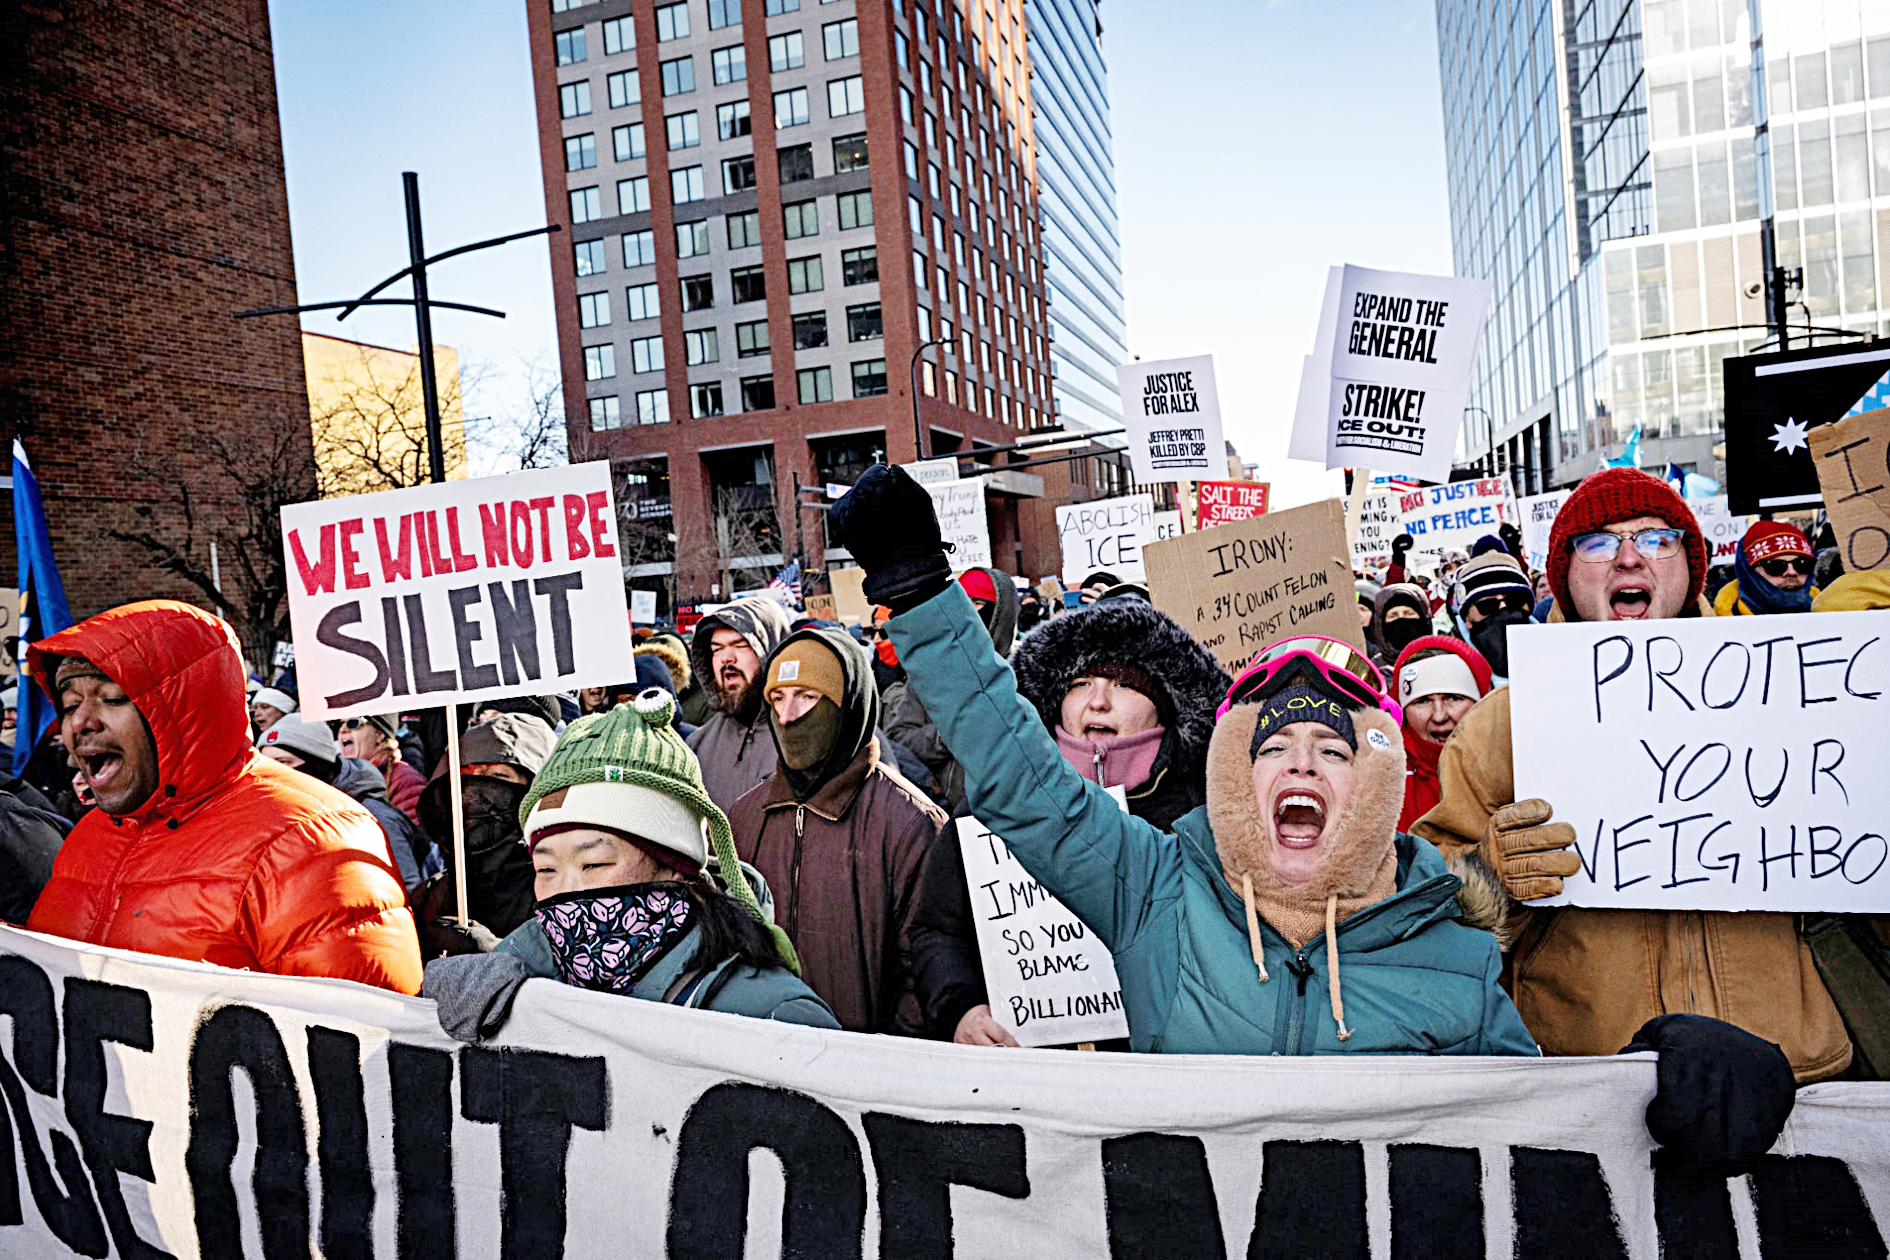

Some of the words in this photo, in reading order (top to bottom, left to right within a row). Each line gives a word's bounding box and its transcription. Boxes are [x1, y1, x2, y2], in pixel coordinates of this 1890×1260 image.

[1353, 291, 1413, 323] EXPAND
[1415, 299, 1449, 328] THE
[1348, 320, 1438, 364] GENERAL
[1143, 371, 1194, 395] JUSTICE
[1143, 395, 1169, 416] FOR
[1170, 392, 1200, 414] ALEX
[1342, 383, 1426, 424] STRIKE!
[1147, 429, 1178, 444] JEFFREY
[1179, 428, 1205, 441] PRETTI
[1337, 419, 1364, 432] ICE
[1366, 420, 1426, 440] OUT!
[1149, 443, 1178, 458] KILLED
[1179, 442, 1190, 456] BY
[1190, 442, 1206, 456] CBP
[920, 468, 951, 480] person
[1201, 484, 1234, 506] SALT
[1238, 488, 1264, 506] THE
[1377, 496, 1387, 509] IS
[1400, 491, 1424, 513] NO
[1431, 480, 1503, 505] JUSTICE
[1061, 501, 1151, 538] ABOLISH
[1211, 504, 1255, 521] STREETS
[1360, 511, 1388, 523] MING
[1405, 520, 1426, 535] NO
[1431, 507, 1495, 530] PEACE
[288, 518, 371, 596] WE
[373, 506, 478, 583] WILL
[478, 496, 555, 569] NOT
[563, 491, 616, 560] BE
[1158, 523, 1175, 540] CE
[1355, 540, 1390, 553] ENING?
[1360, 526, 1380, 538] YOU
[1713, 523, 1738, 537] ON
[1086, 533, 1138, 569] ICE
[1207, 532, 1292, 577] IRONY:
[1197, 607, 1205, 622] A
[1233, 583, 1281, 618] COUNT
[1283, 570, 1328, 597] FELON
[1239, 611, 1283, 646] RAPIST
[1289, 593, 1335, 626] CALLING
[316, 571, 583, 709] SILENT
[1592, 634, 1884, 724] PROTEC
[1259, 695, 1342, 730] #LOVE
[1639, 738, 1849, 808] YOUR
[980, 880, 1053, 921] IMM
[1002, 929, 1035, 956] SO
[1039, 921, 1085, 949] YOU
[1017, 953, 1089, 981] BLAME
[1008, 991, 1123, 1027] BILLIONAI
[187, 1003, 611, 1260] OUT
